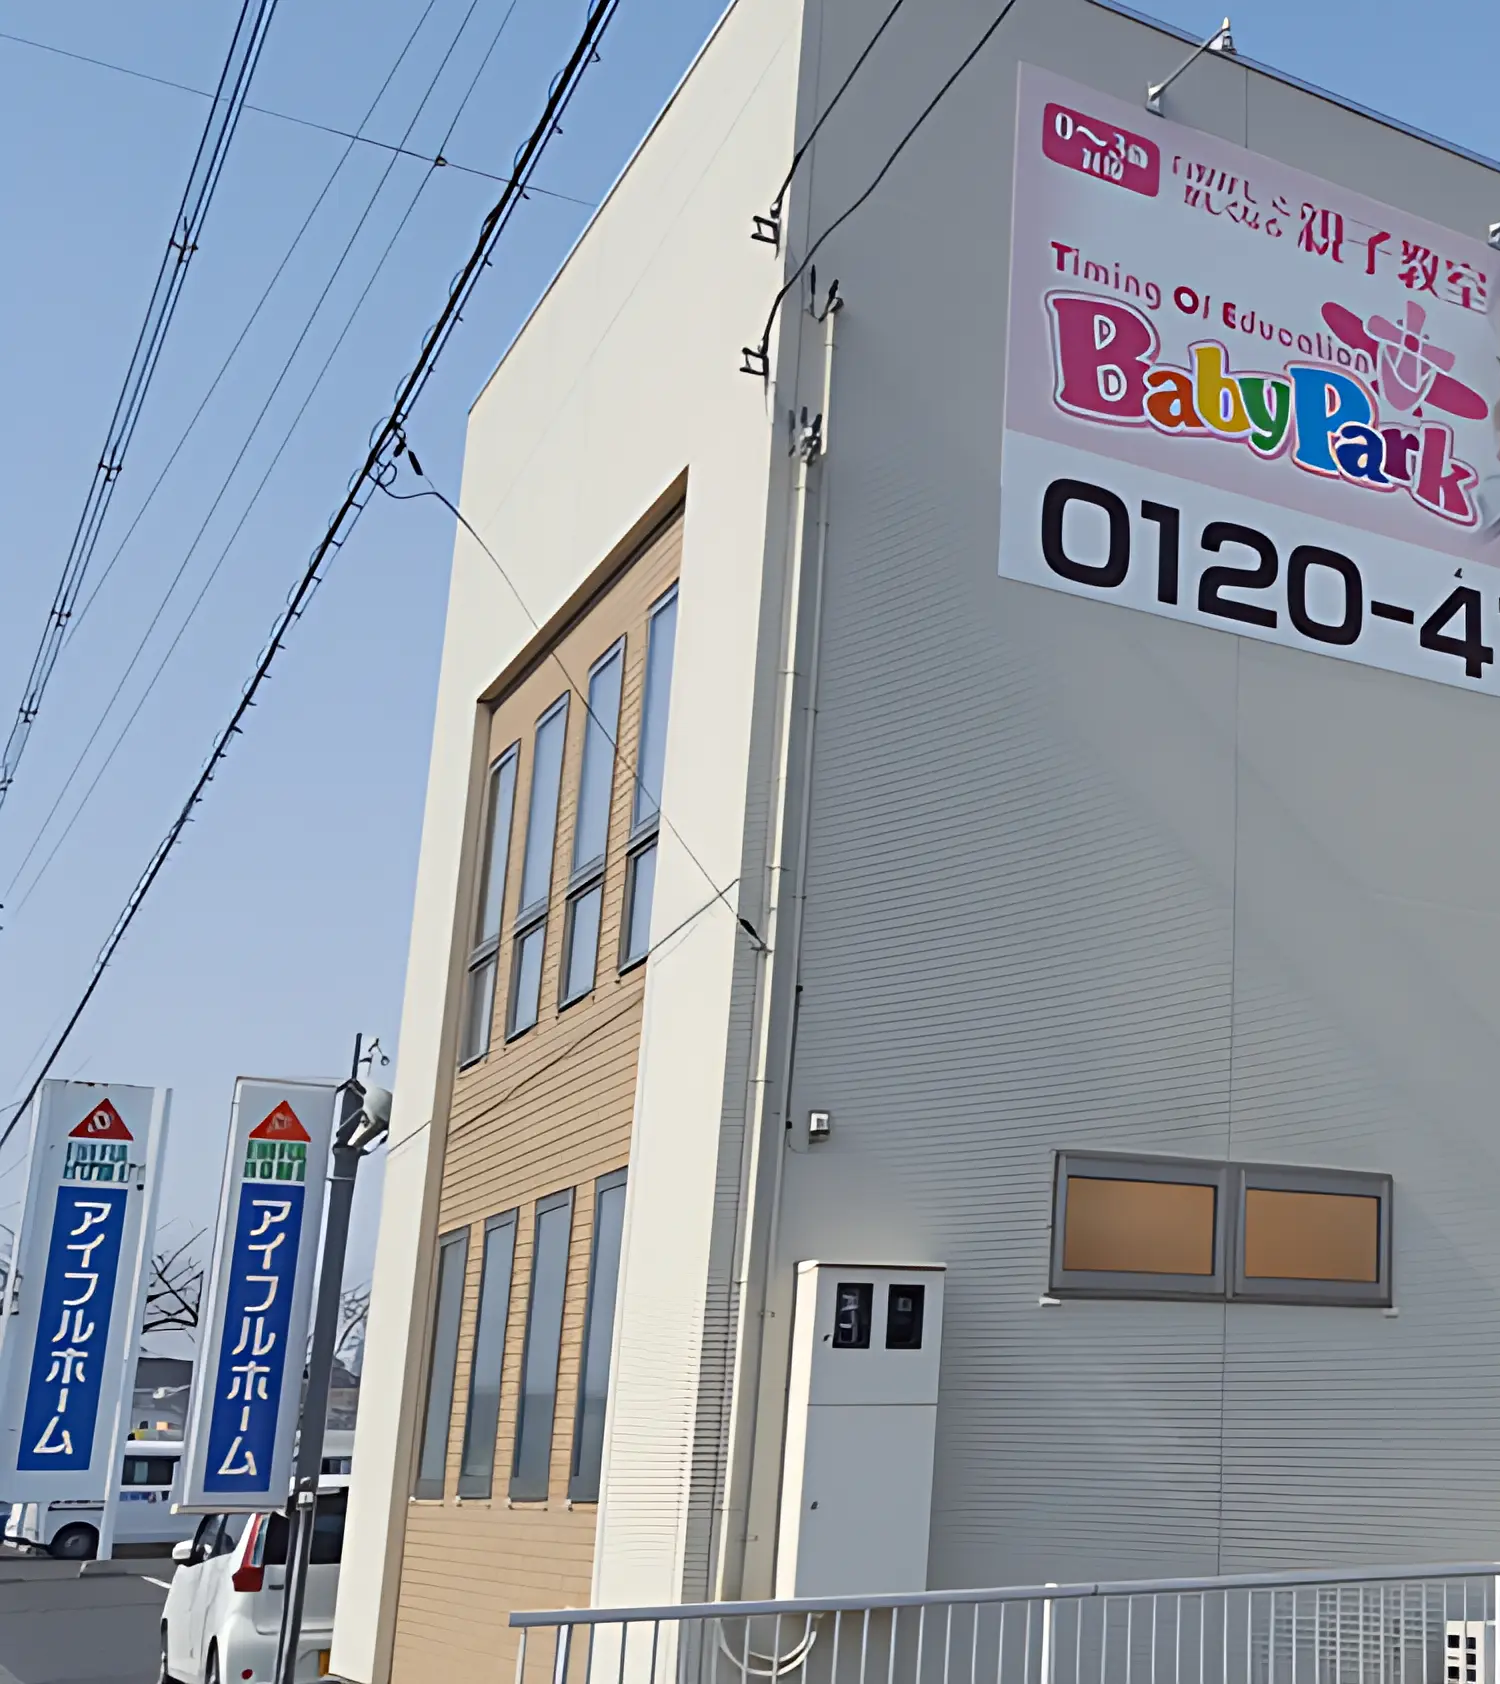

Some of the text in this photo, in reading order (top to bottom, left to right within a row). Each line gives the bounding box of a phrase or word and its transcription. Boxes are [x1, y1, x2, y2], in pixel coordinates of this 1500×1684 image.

[1051, 241, 1161, 310] Timing
[32, 1201, 112, 1455] アイフルホーム
[216, 1199, 292, 1477] アイフルホーム
